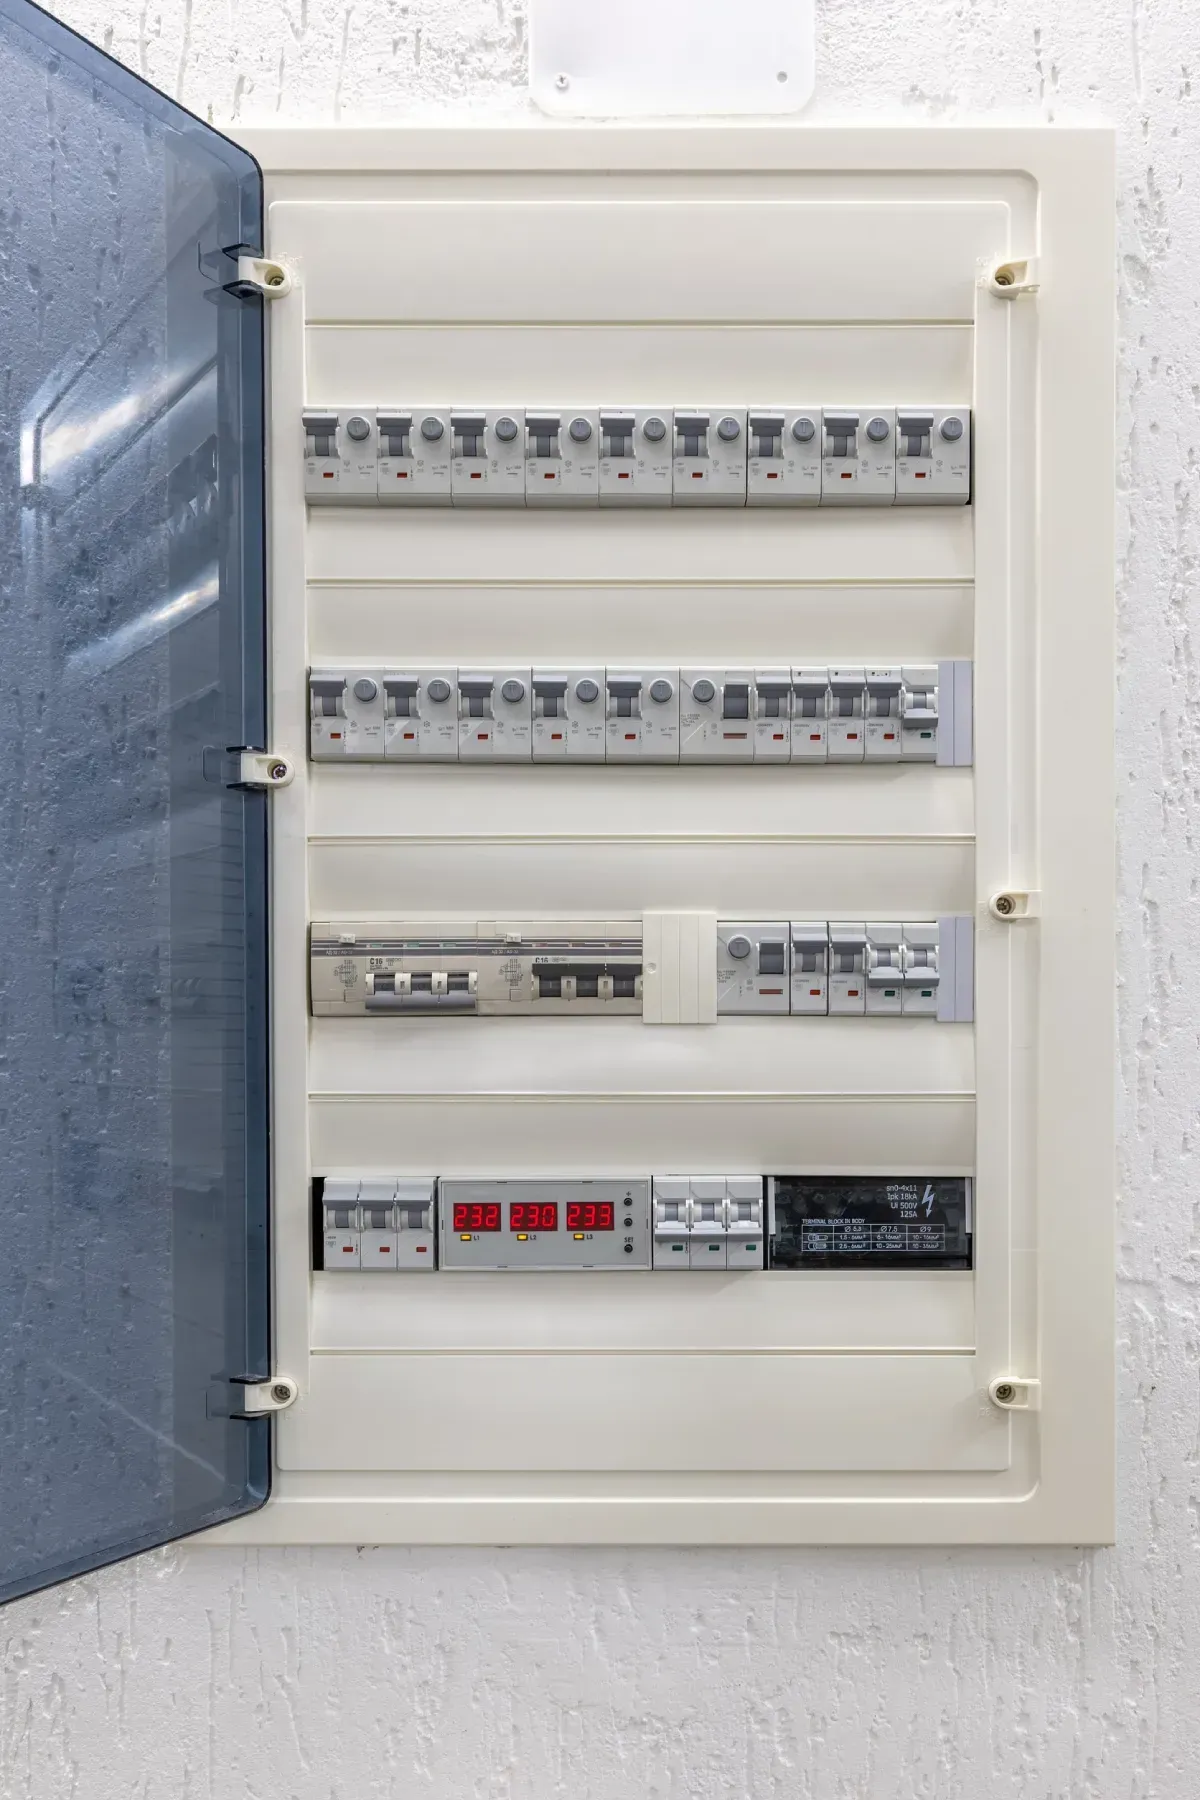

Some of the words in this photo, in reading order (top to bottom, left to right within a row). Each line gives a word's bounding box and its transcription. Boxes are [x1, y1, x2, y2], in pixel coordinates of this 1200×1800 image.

[455, 1206, 498, 1226] 232
[511, 1206, 554, 1226] 230
[568, 1205, 610, 1226] 233
